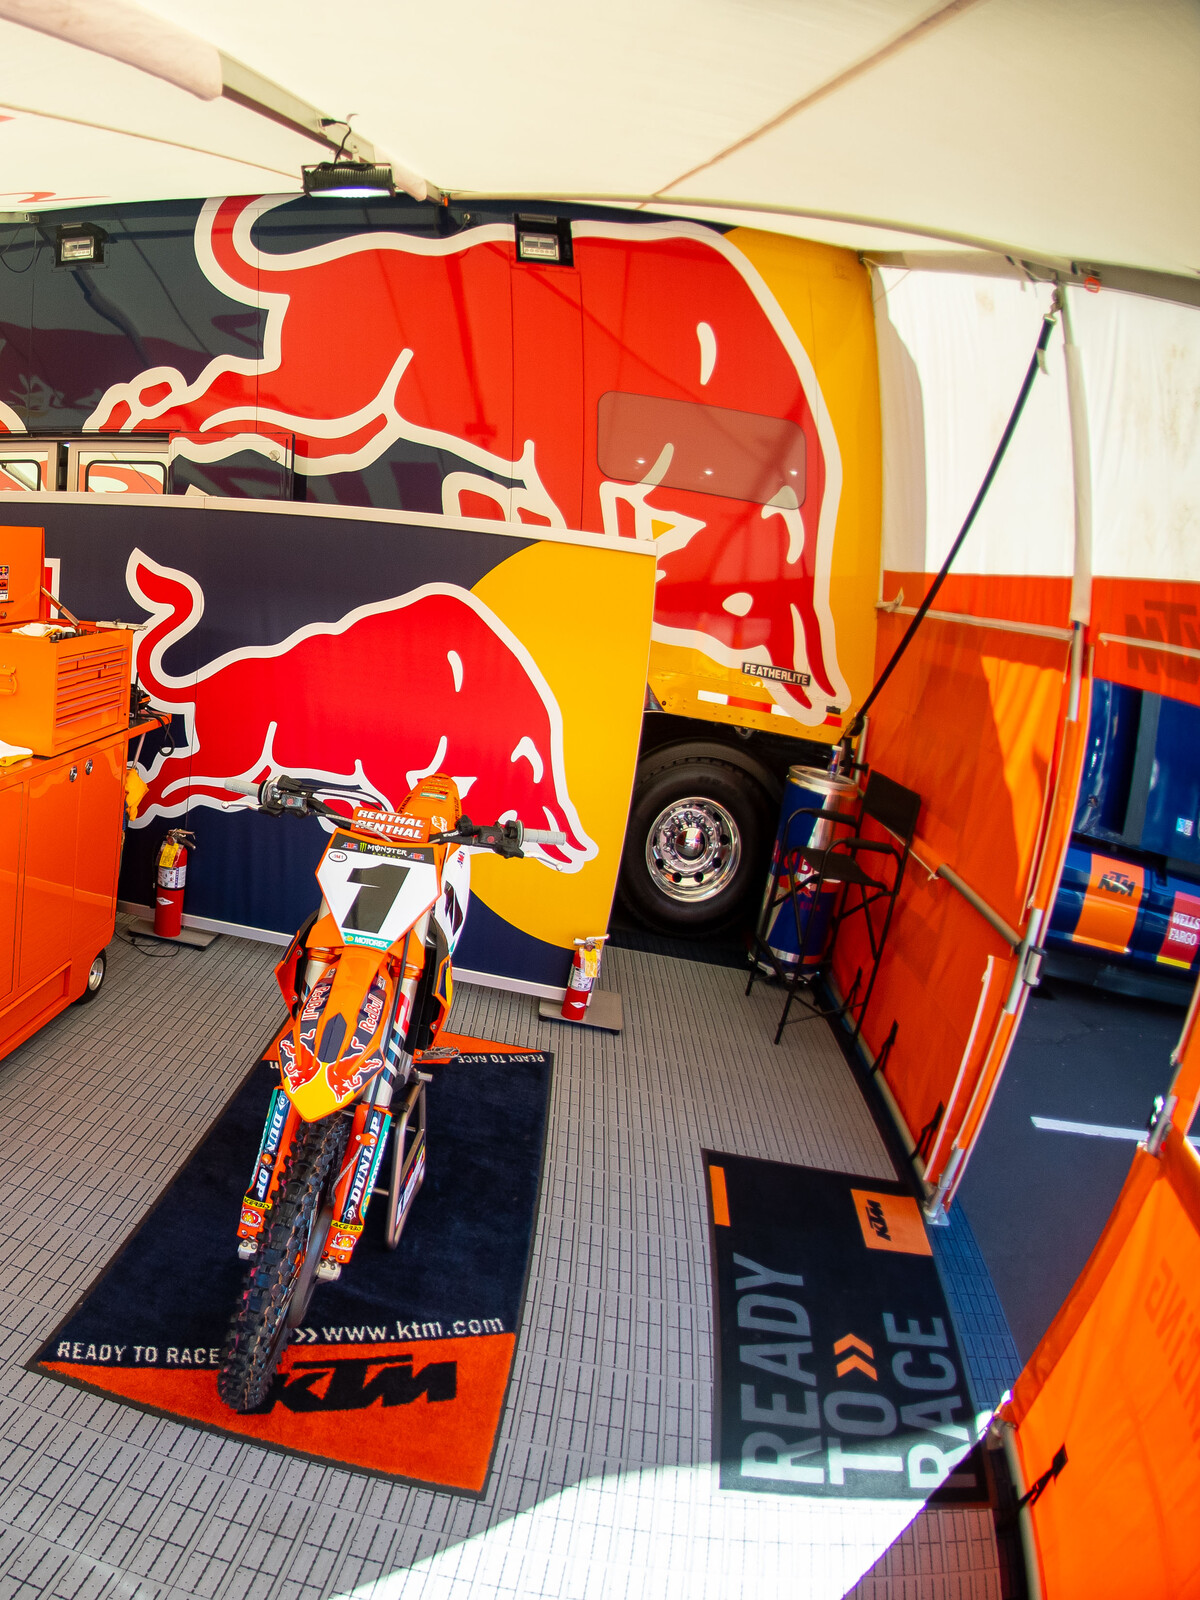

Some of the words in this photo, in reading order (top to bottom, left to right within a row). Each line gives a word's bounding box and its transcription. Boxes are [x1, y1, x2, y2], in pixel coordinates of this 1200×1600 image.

[744, 663, 808, 685] FEATHERLITE
[355, 819, 423, 839] RENTHAL
[357, 809, 425, 828] RENTHAL
[367, 844, 407, 857] MONSTER
[1098, 870, 1136, 897] KTM
[341, 863, 411, 934] 1
[354, 935, 389, 949] MOTOREX
[1168, 927, 1198, 946] FARGO
[457, 1054, 487, 1063] RACE
[492, 1054, 506, 1063] TO
[510, 1053, 545, 1063] READY
[257, 1112, 284, 1198] DUNOP
[867, 1199, 891, 1241] KTM
[324, 1317, 505, 1341] www.ktm.com
[57, 1342, 126, 1363] READY
[134, 1346, 158, 1364] TO
[167, 1347, 220, 1365] RACE
[733, 1252, 825, 1484] READY
[237, 1354, 457, 1415] KTM
[882, 1312, 977, 1489] RACE
[824, 1391, 903, 1485] TO
